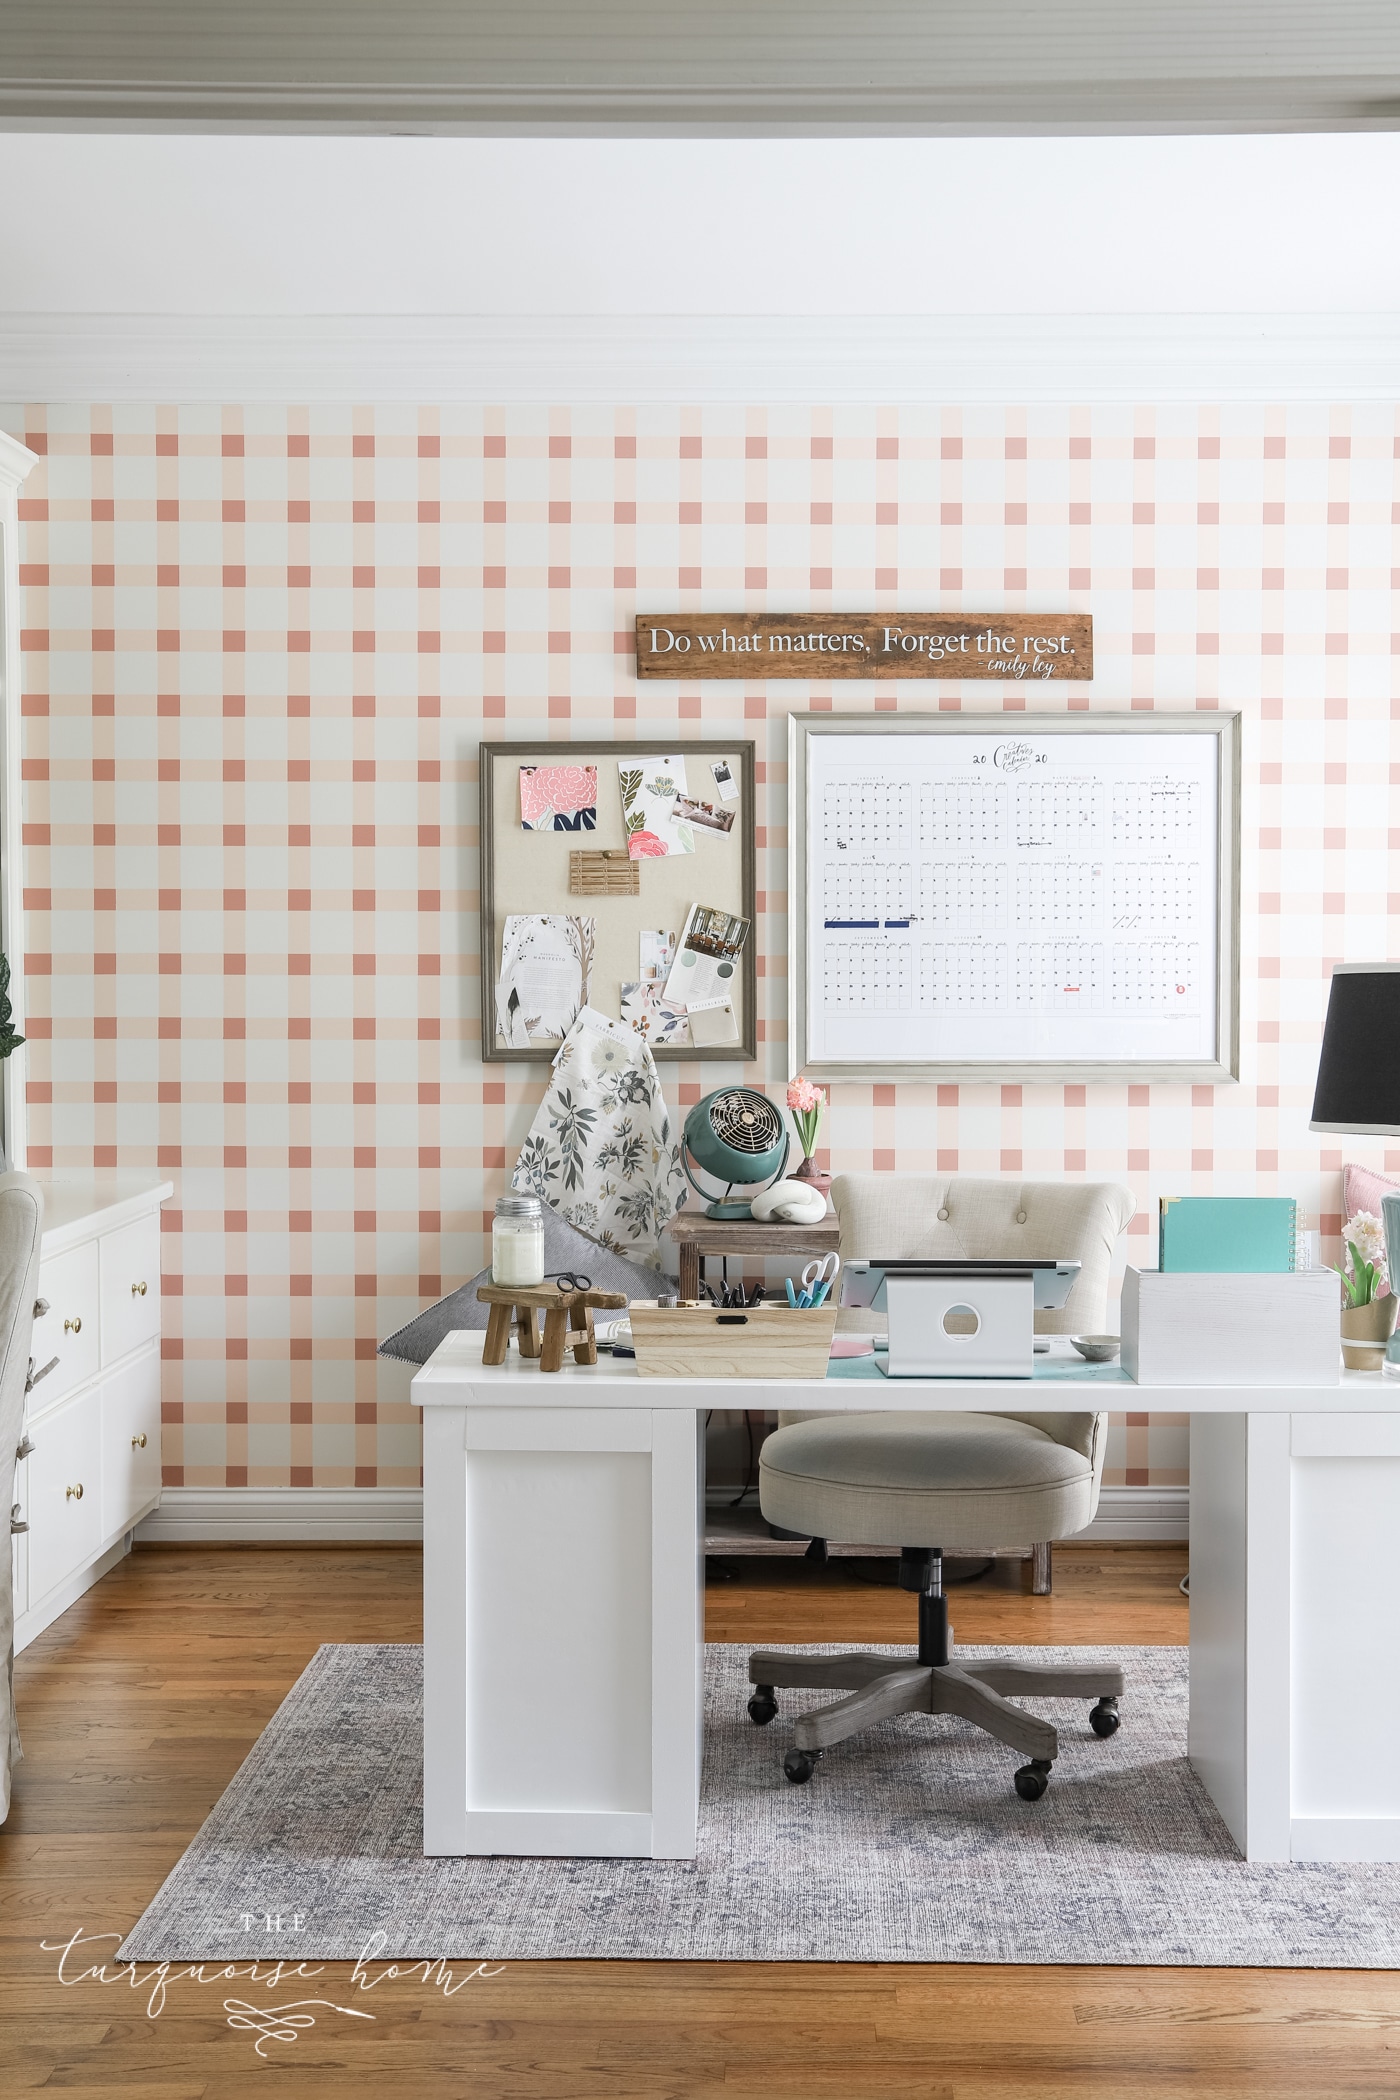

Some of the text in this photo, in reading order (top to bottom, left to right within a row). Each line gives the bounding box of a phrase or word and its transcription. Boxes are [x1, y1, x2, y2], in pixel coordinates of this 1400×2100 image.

[649, 628, 691, 653] Do
[697, 628, 762, 653] what
[881, 627, 970, 660] Forget
[976, 629, 1016, 653] the
[1022, 635, 1076, 654] rest.
[987, 654, 1030, 679] emily
[1032, 654, 1056, 680] ley
[973, 755, 987, 764] 20
[1035, 754, 1048, 764] 20
